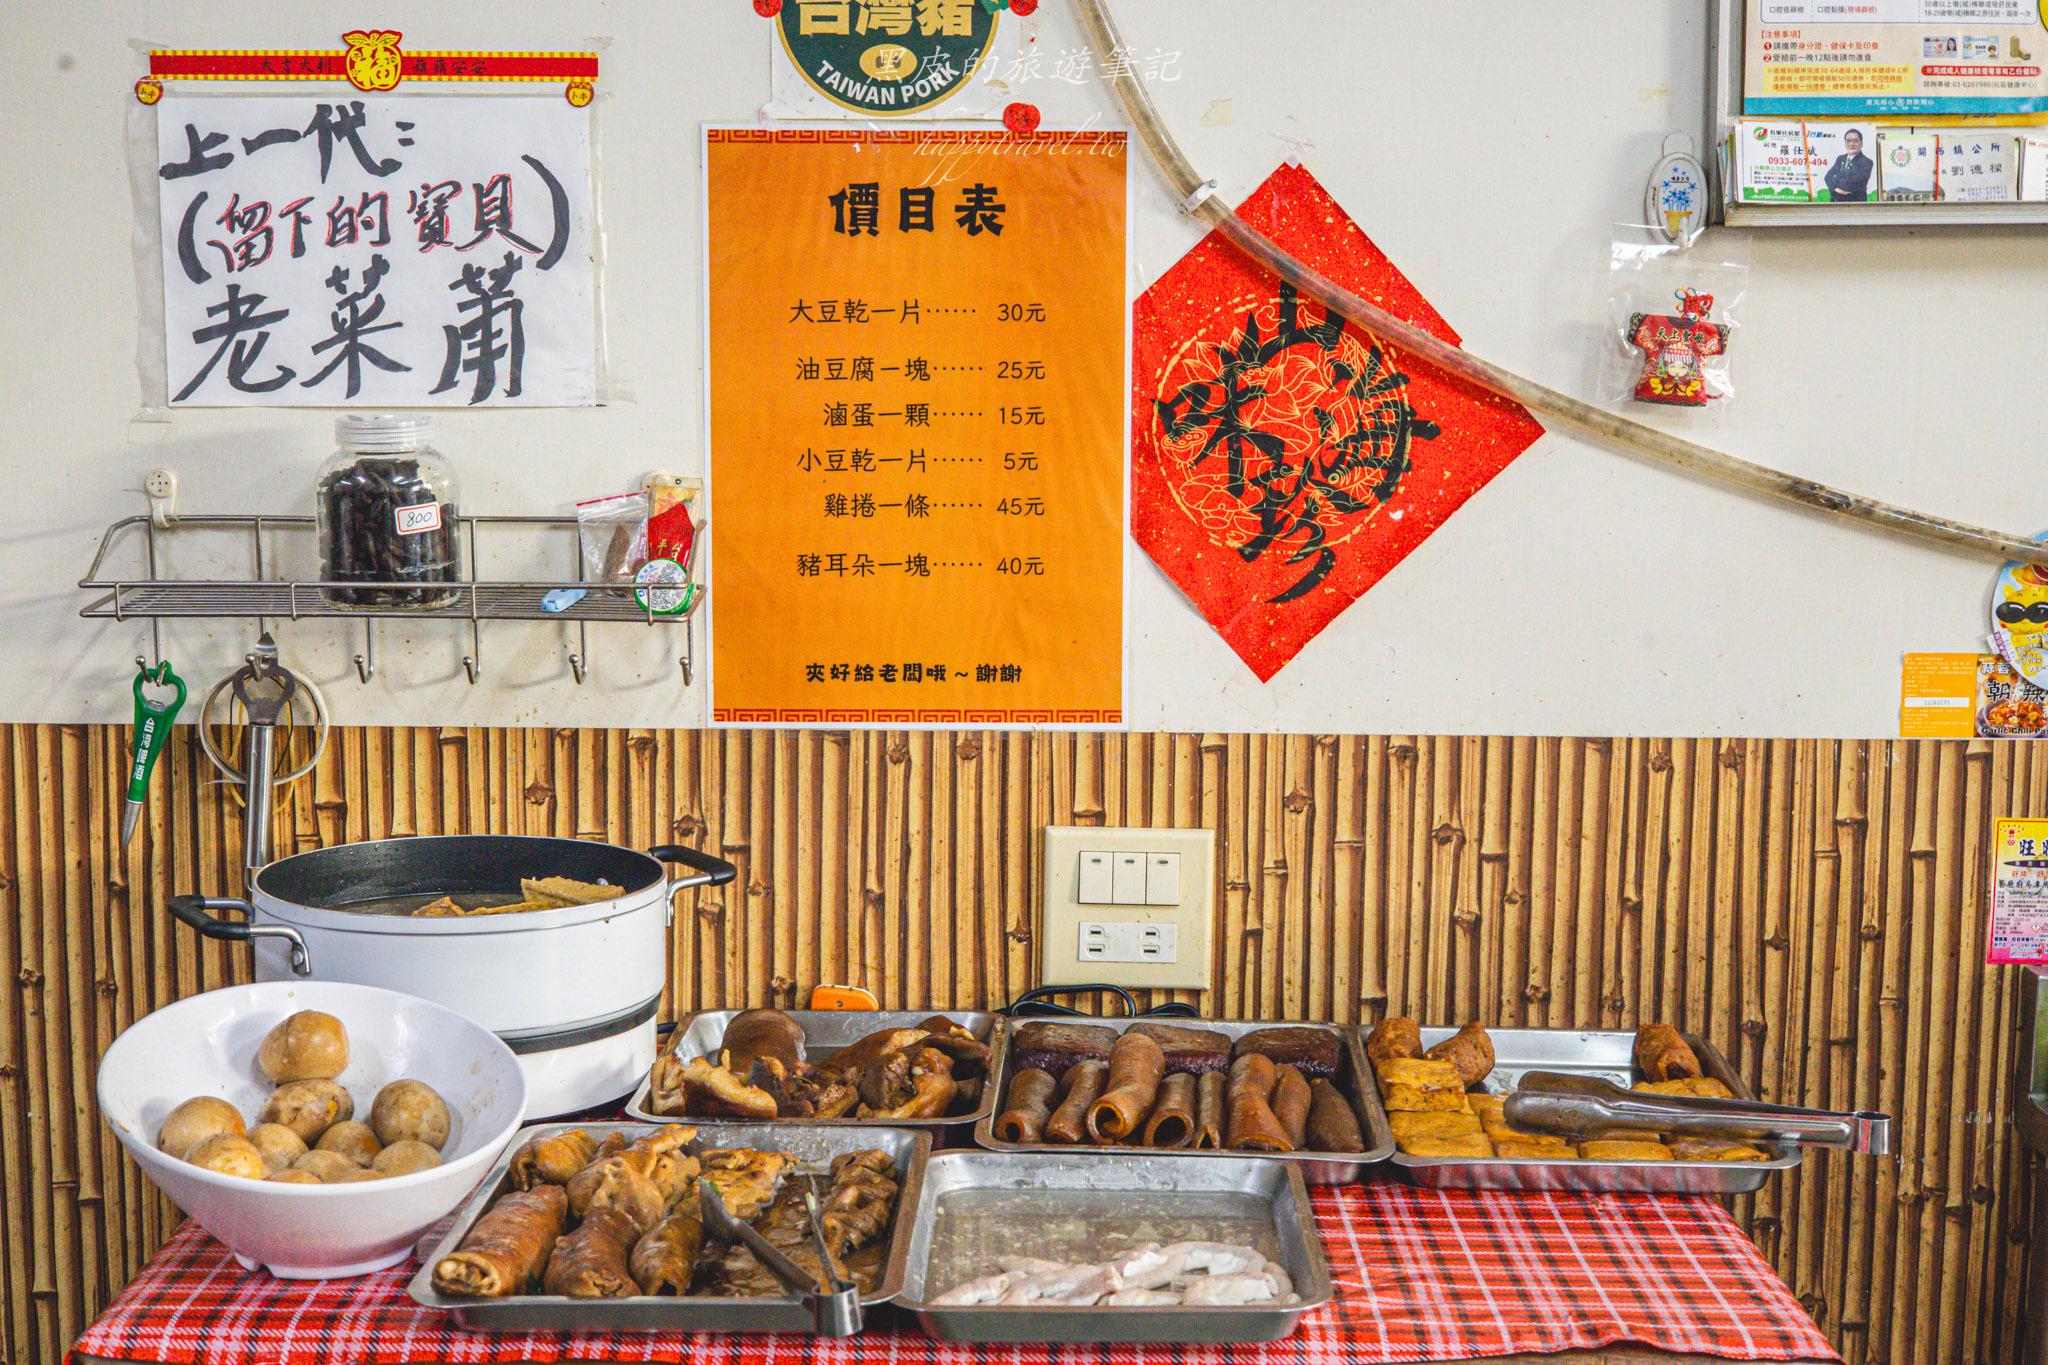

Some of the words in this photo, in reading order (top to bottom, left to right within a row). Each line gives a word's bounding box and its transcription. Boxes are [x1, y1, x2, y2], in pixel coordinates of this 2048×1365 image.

[796, 0, 976, 36] 台灣豬
[261, 58, 332, 73] 大吉大利
[817, 60, 895, 105] TAIWAN
[901, 61, 960, 104] PORK
[1768, 157, 1829, 166] 0933-607-494
[828, 182, 1006, 237] 價目表
[997, 303, 1045, 322] 30元
[997, 361, 1045, 380] 25元
[998, 407, 1045, 425] 15元
[1004, 452, 1038, 471] 5元
[997, 497, 1045, 516] 45元
[406, 511, 432, 527] 800
[997, 557, 1045, 575] 40元
